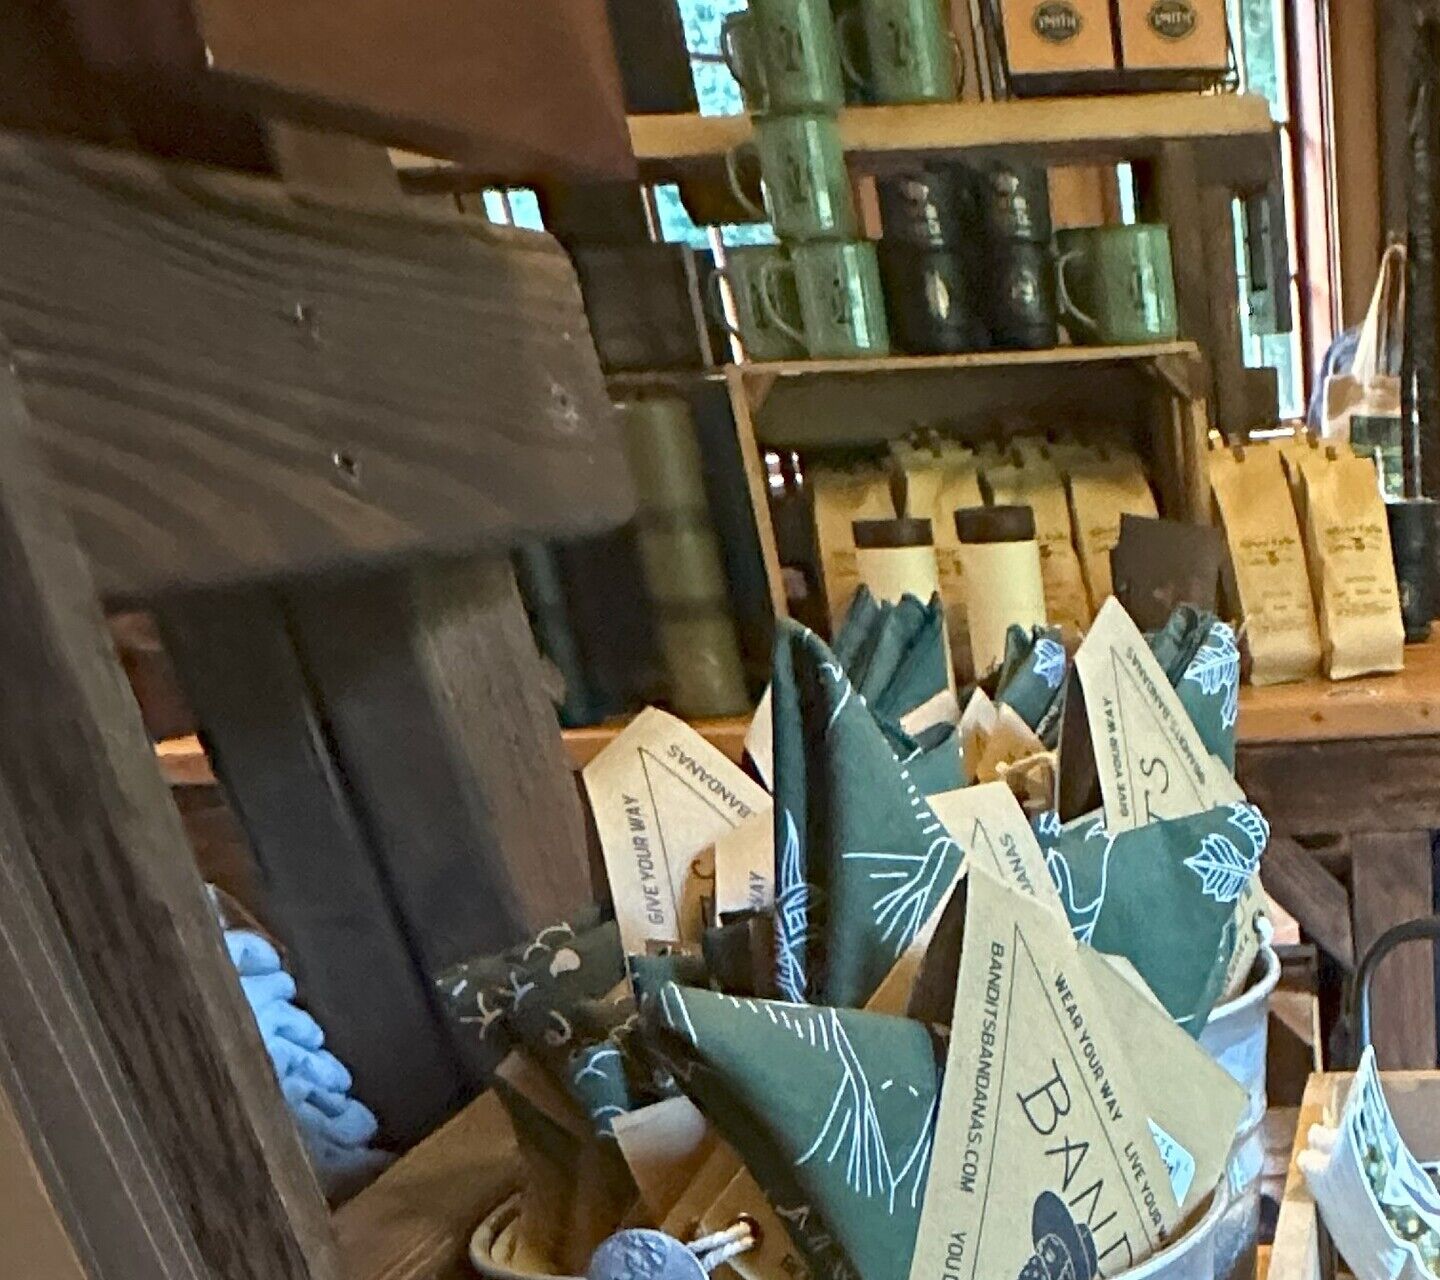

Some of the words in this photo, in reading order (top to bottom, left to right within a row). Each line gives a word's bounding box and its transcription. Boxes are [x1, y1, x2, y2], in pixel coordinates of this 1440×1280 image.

[667, 743, 750, 819] BANDANAS
[621, 793, 646, 833] WAY
[632, 837, 654, 882] YOUR
[641, 882, 665, 926] GIVE
[959, 941, 1006, 1194] BANDITSBANDANAS.COM
[1054, 972, 1084, 1031] WEAR
[1078, 1029, 1105, 1082] YOUR
[1099, 1078, 1123, 1122] WAY
[1124, 1141, 1147, 1183] LIVE
[1141, 1178, 1162, 1228] YOUR
[944, 1230, 968, 1273] YOU
